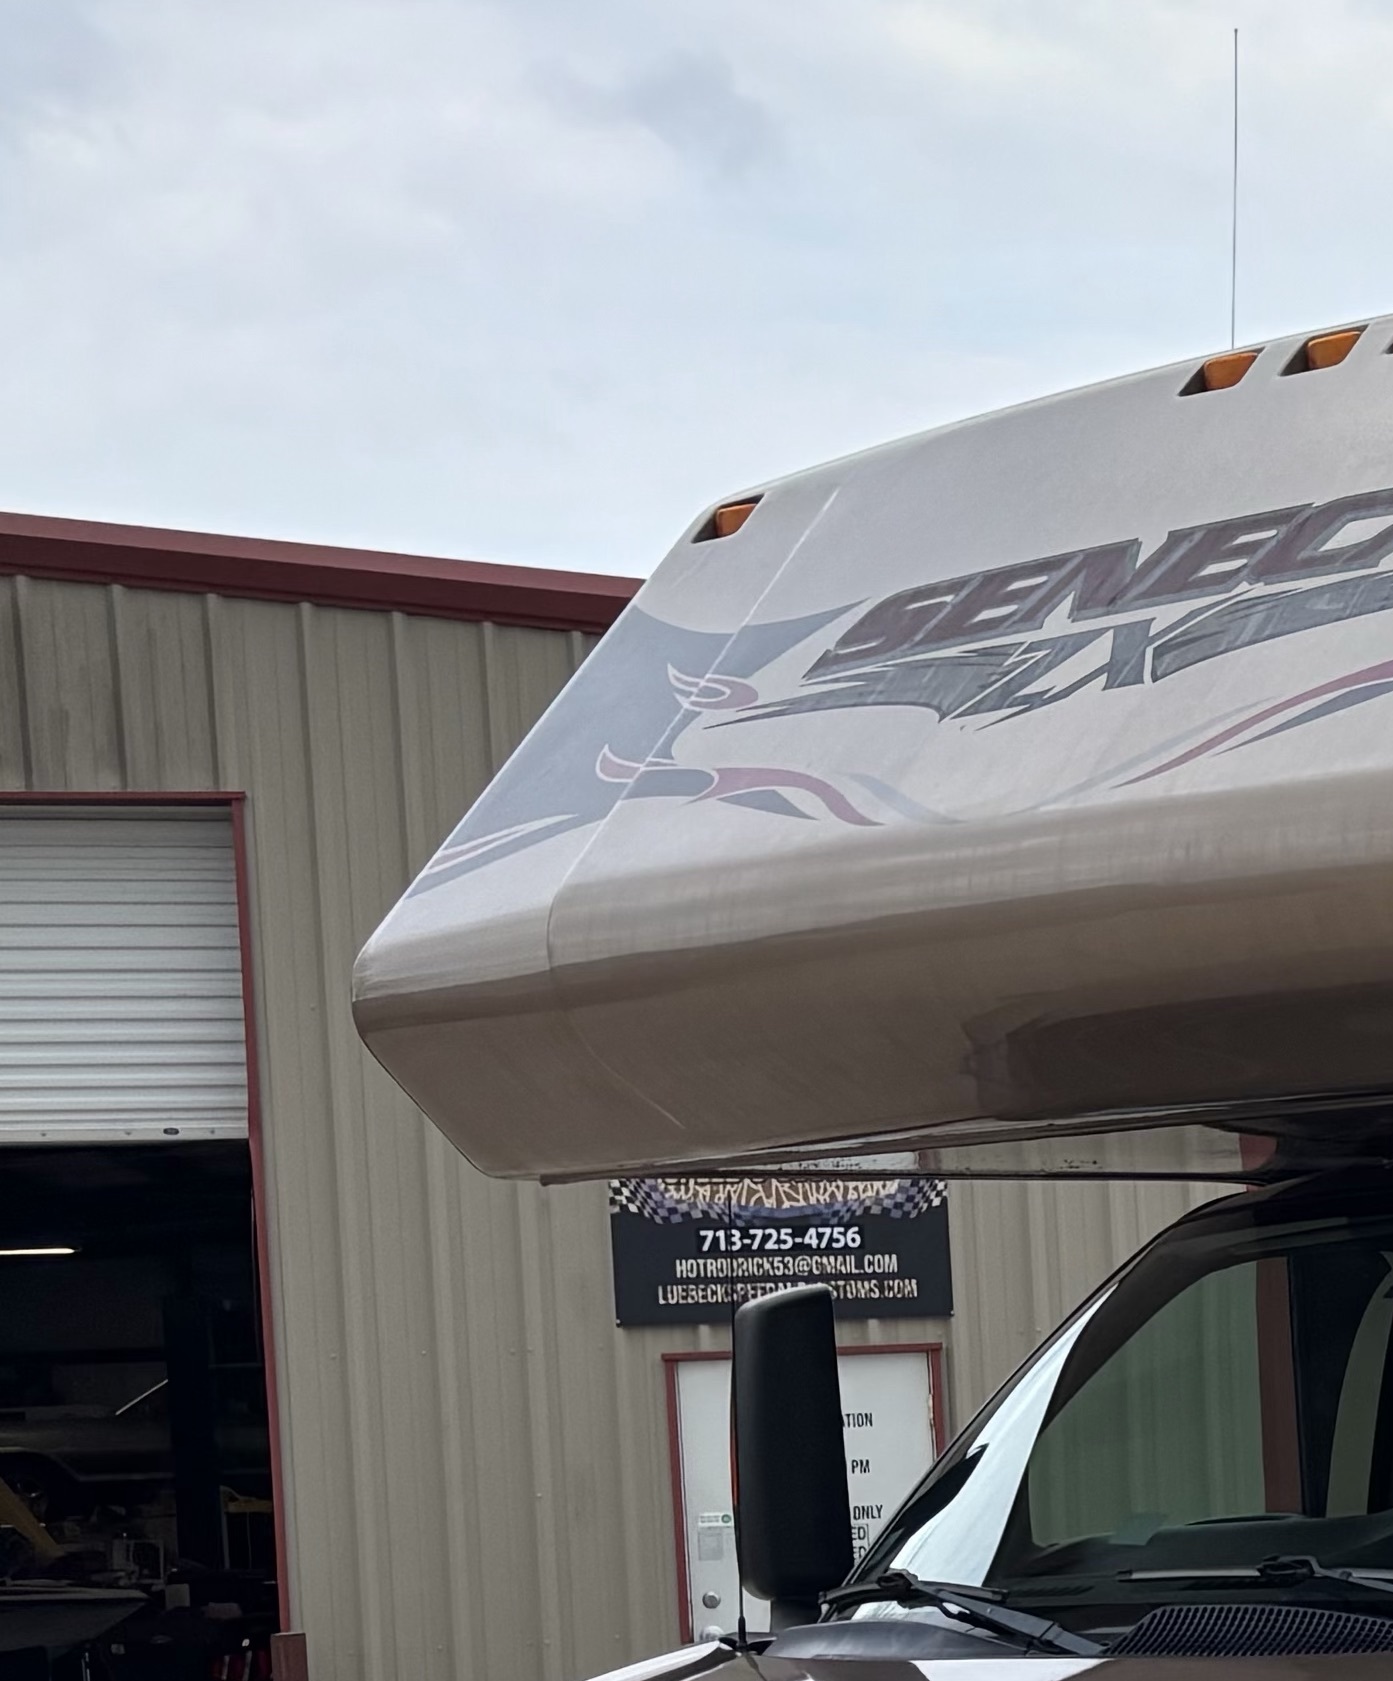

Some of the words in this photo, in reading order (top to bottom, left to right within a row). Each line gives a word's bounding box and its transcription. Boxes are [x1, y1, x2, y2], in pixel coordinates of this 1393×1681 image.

[699, 1226, 862, 1252] 713-725-4756
[851, 1459, 870, 1474] PM
[853, 1504, 883, 1521] ONLY
